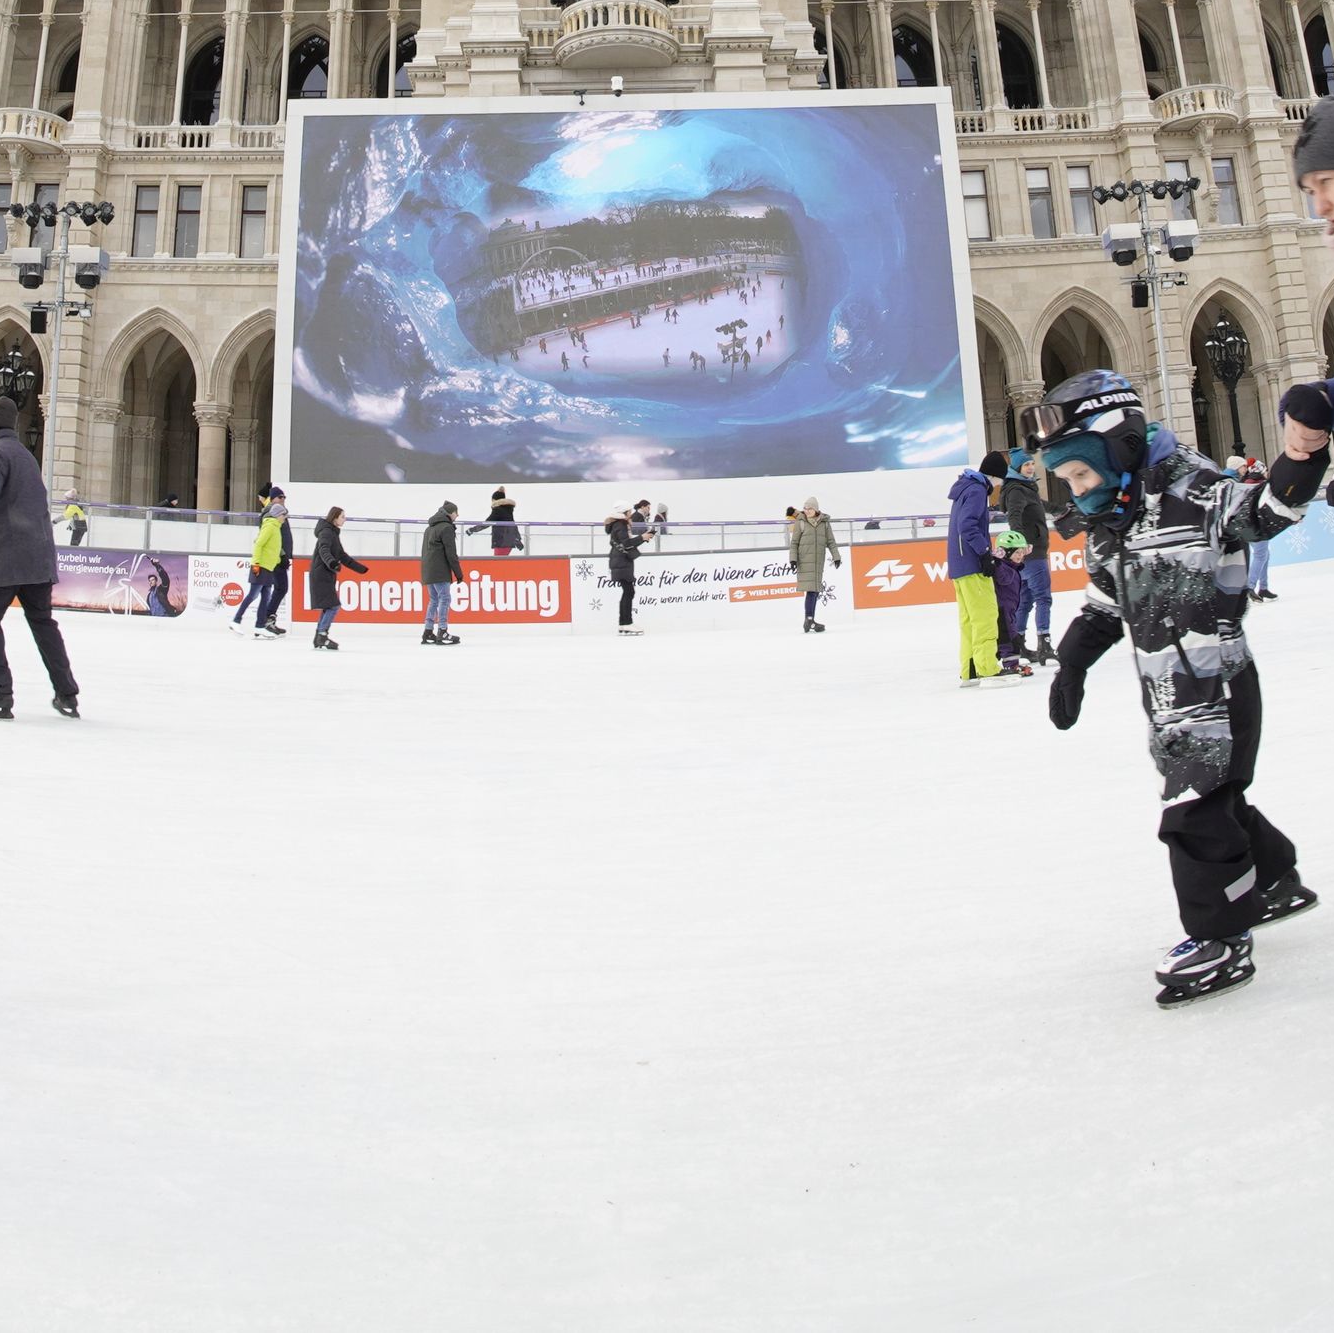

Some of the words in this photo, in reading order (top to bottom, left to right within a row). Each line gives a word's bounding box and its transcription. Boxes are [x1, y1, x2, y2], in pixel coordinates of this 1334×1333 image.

[1074, 392, 1141, 414] ALPINA
[57, 553, 87, 563] kurbeln
[88, 555, 102, 564] wir
[193, 559, 209, 568] Das
[59, 563, 113, 575] Energiewende
[115, 567, 129, 575] an.
[193, 569, 229, 578] GoGreen
[597, 572, 655, 588] Traueis
[658, 570, 680, 588] für
[682, 568, 707, 583] den
[713, 566, 759, 581] Wiener
[193, 579, 220, 588] Konto.
[303, 570, 423, 612] onen
[449, 570, 559, 617] eitung
[748, 588, 769, 597] WIEN
[770, 586, 797, 595] ENERGI
[639, 596, 658, 606] Wer,
[686, 590, 709, 602] nicht
[711, 591, 727, 601] wir.
